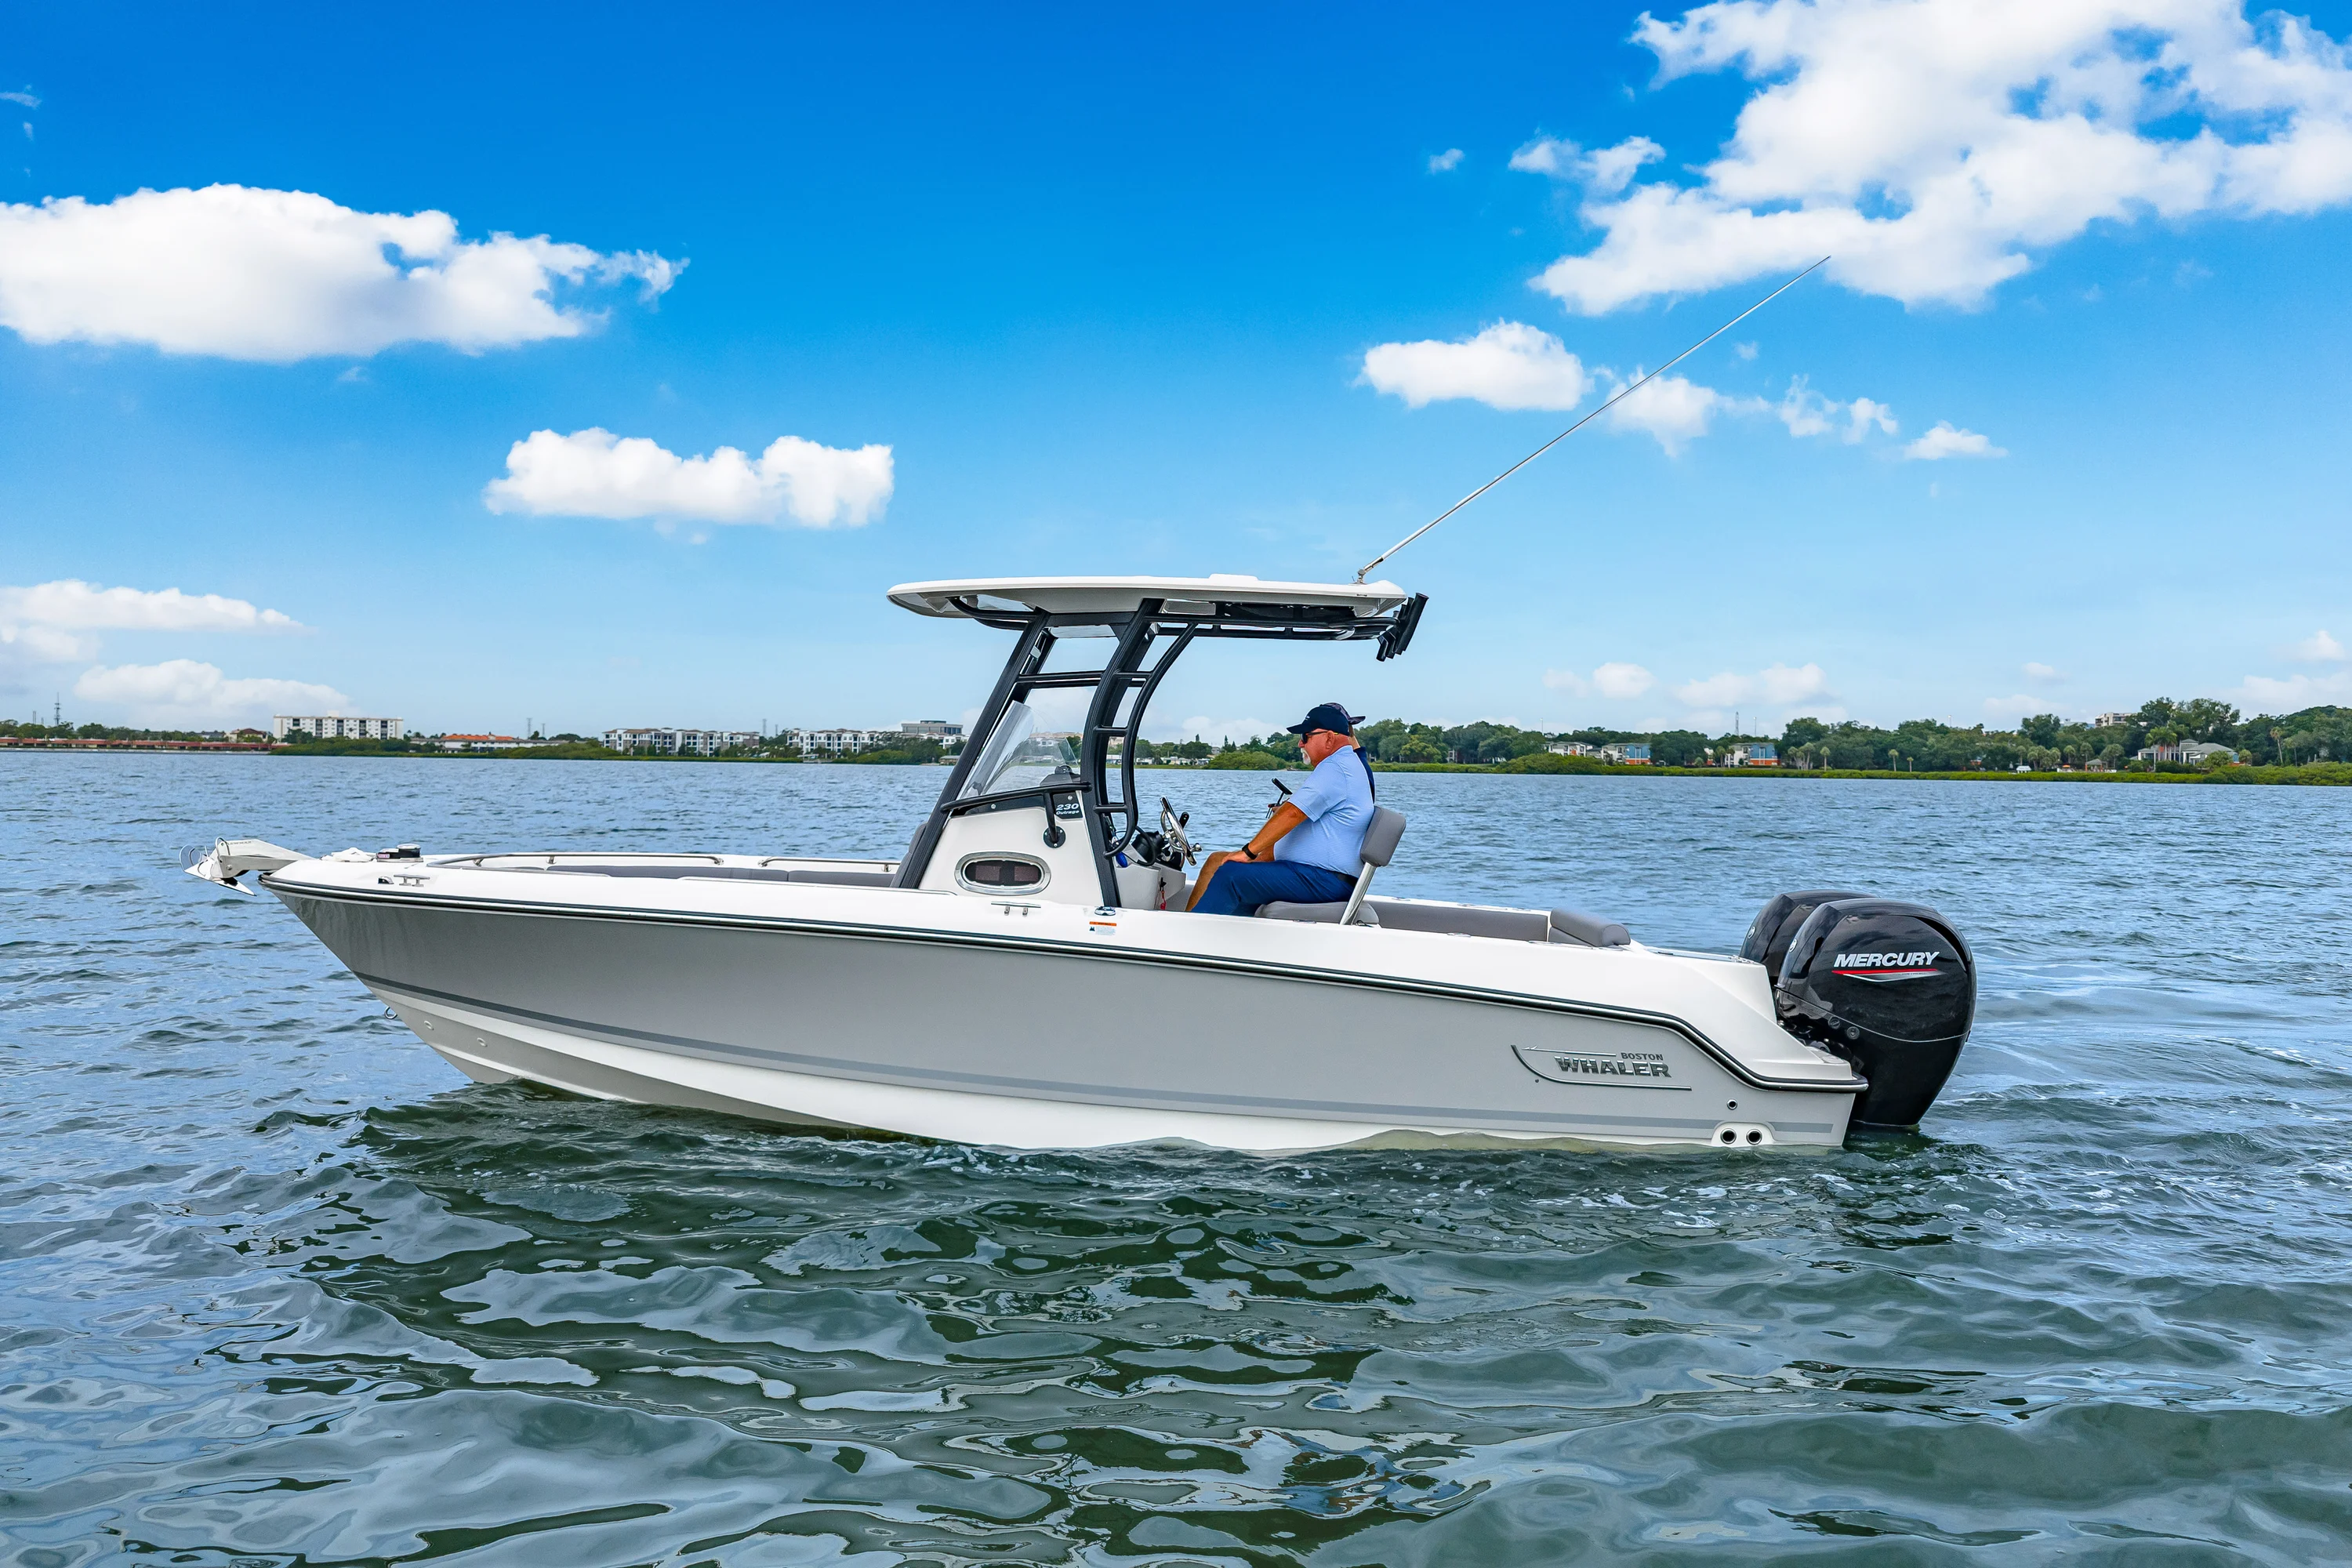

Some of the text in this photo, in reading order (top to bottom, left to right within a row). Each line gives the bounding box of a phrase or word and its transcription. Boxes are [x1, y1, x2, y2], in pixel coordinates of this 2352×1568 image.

[1833, 951, 1940, 967] MERCURY
[1621, 1052, 1664, 1061] BOSTON
[1554, 1056, 1672, 1078] WHALER
